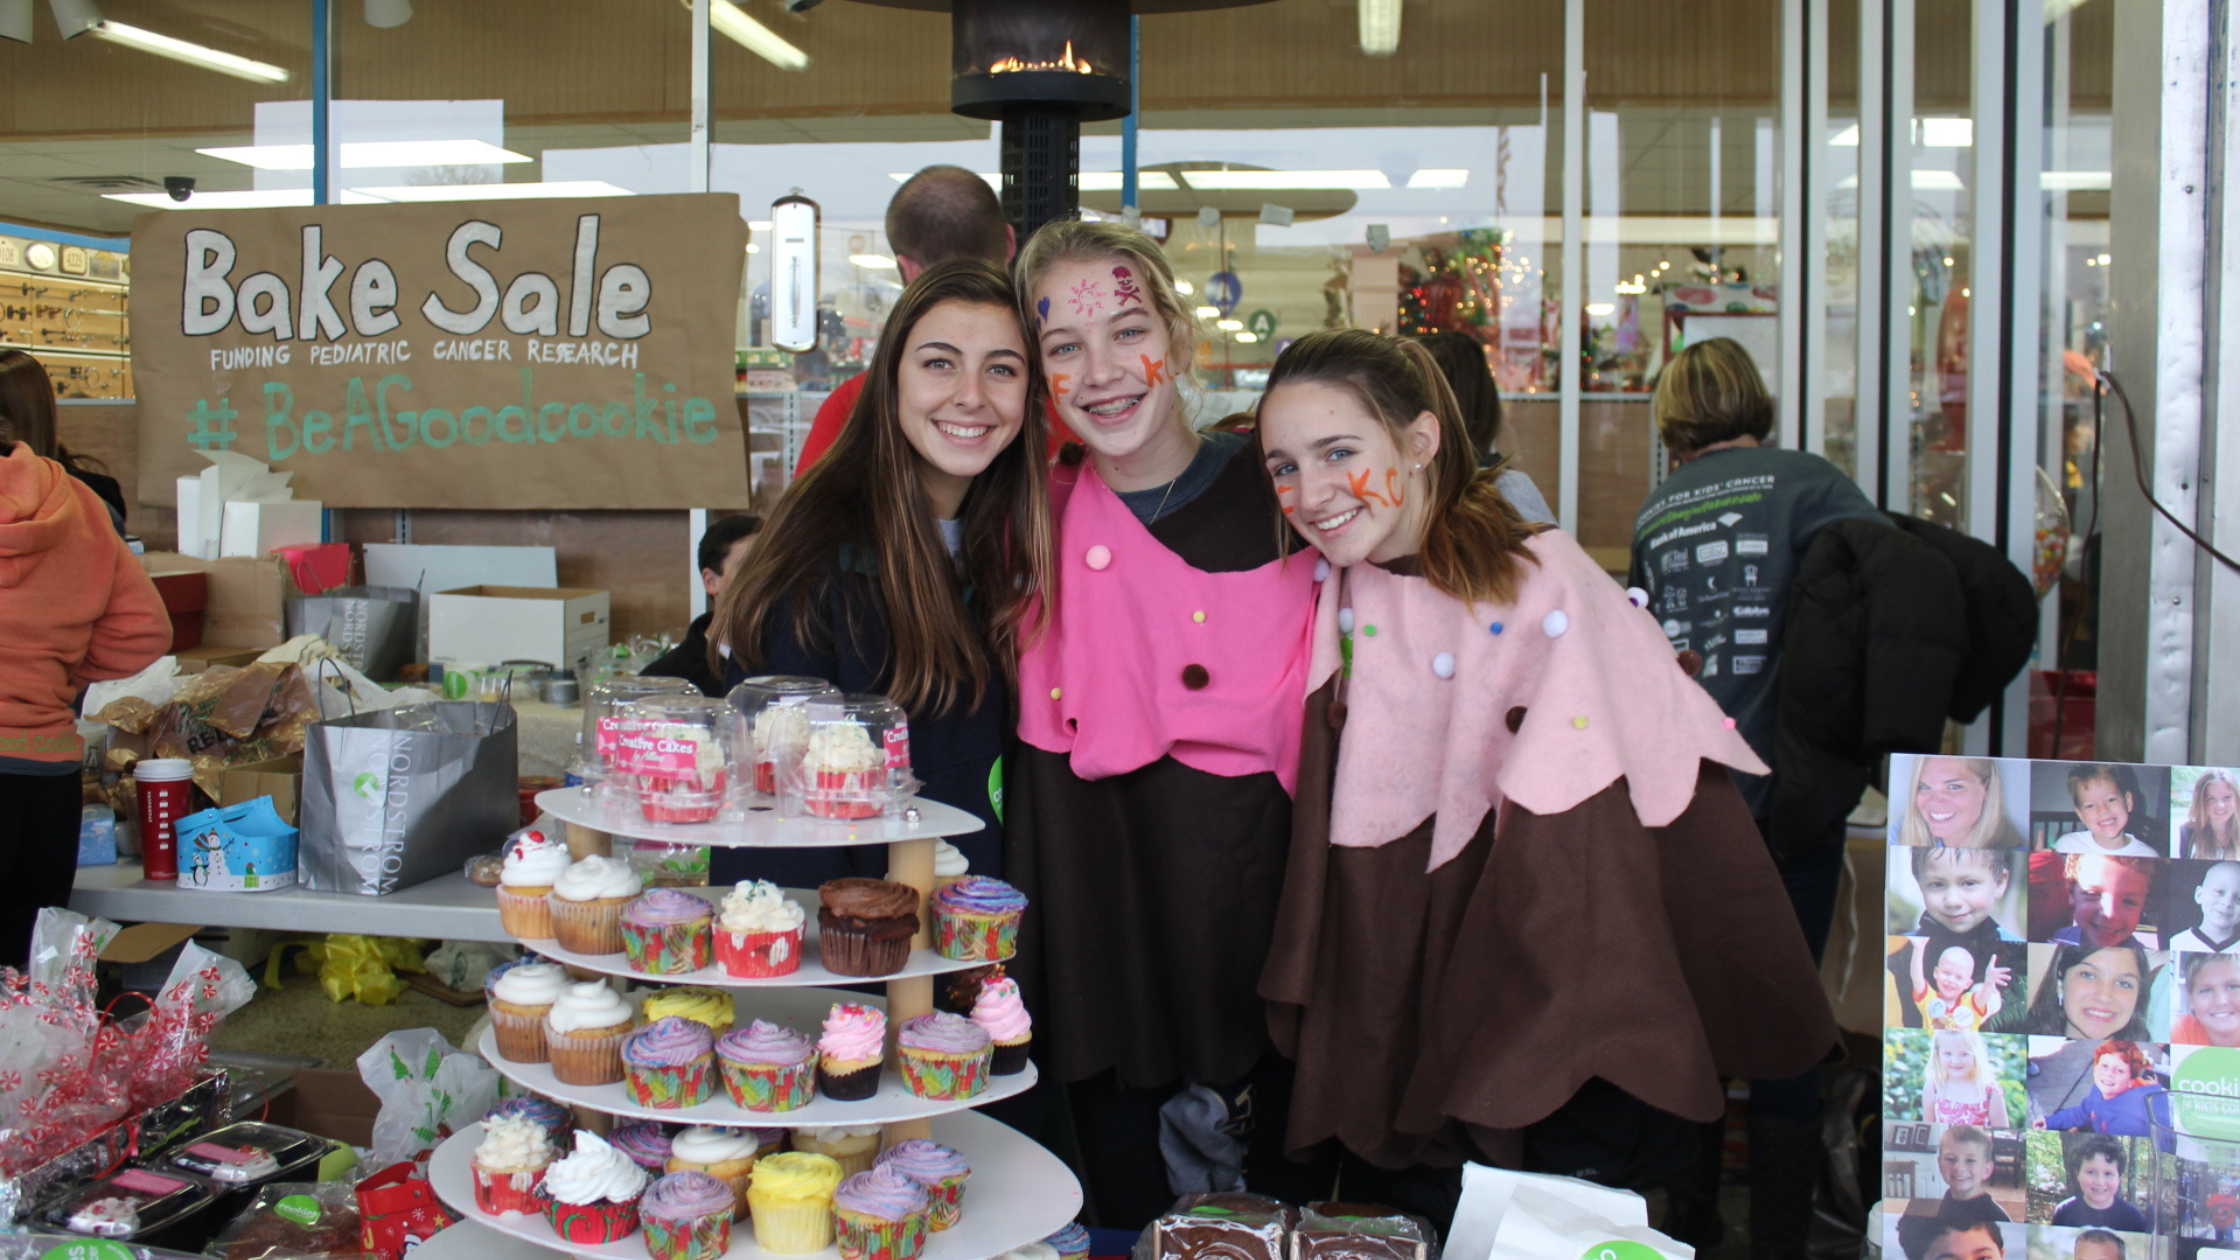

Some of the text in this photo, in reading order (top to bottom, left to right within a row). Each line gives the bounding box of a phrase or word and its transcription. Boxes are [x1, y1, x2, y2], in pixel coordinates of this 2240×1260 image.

[182, 213, 652, 342] Bake Sale
[210, 339, 639, 371] FUNDING PEDIATRIC CANCER RESEARCH
[1668, 490, 1691, 503] FOR
[1725, 475, 1775, 488] CANCER
[1669, 527, 1679, 544] of
[1679, 520, 1717, 540] America
[618, 734, 693, 755] Creative Cakes
[361, 735, 391, 895] NORSTROM
[379, 735, 413, 895] NORDSTROM
